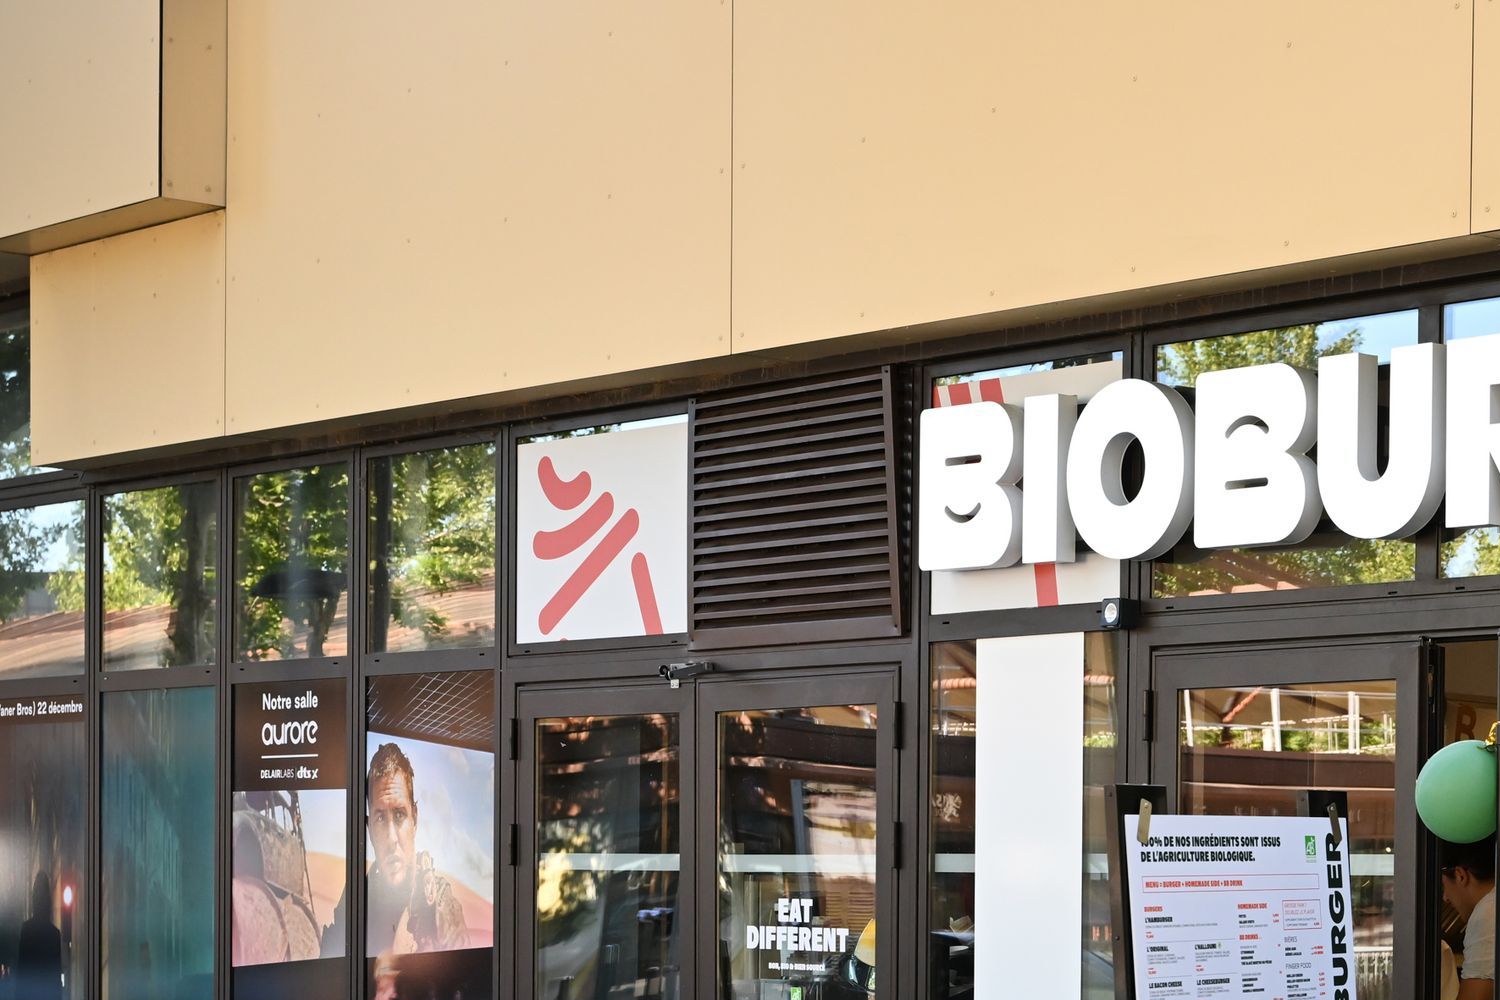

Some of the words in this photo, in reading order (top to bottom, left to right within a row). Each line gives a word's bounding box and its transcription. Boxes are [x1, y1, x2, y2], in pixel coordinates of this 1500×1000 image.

[16, 701, 36, 716] Bros)
[37, 702, 47, 714] 22
[48, 700, 82, 714] décembre
[262, 693, 292, 710] Notre
[294, 690, 318, 708] salle
[262, 720, 318, 746] aurore
[1164, 836, 1174, 847] DE
[1175, 836, 1191, 847] NOS
[1192, 834, 1240, 847] INGRÉDIENTS
[1240, 836, 1259, 847] SONT
[1261, 836, 1280, 847] ISSUS
[1141, 852, 1151, 862] DE
[1152, 851, 1209, 862] L'AGRICULTURE
[1210, 851, 1256, 862] BIOLOGIQUE.
[778, 898, 813, 923] EAT
[746, 925, 849, 952] DIFFERENT
